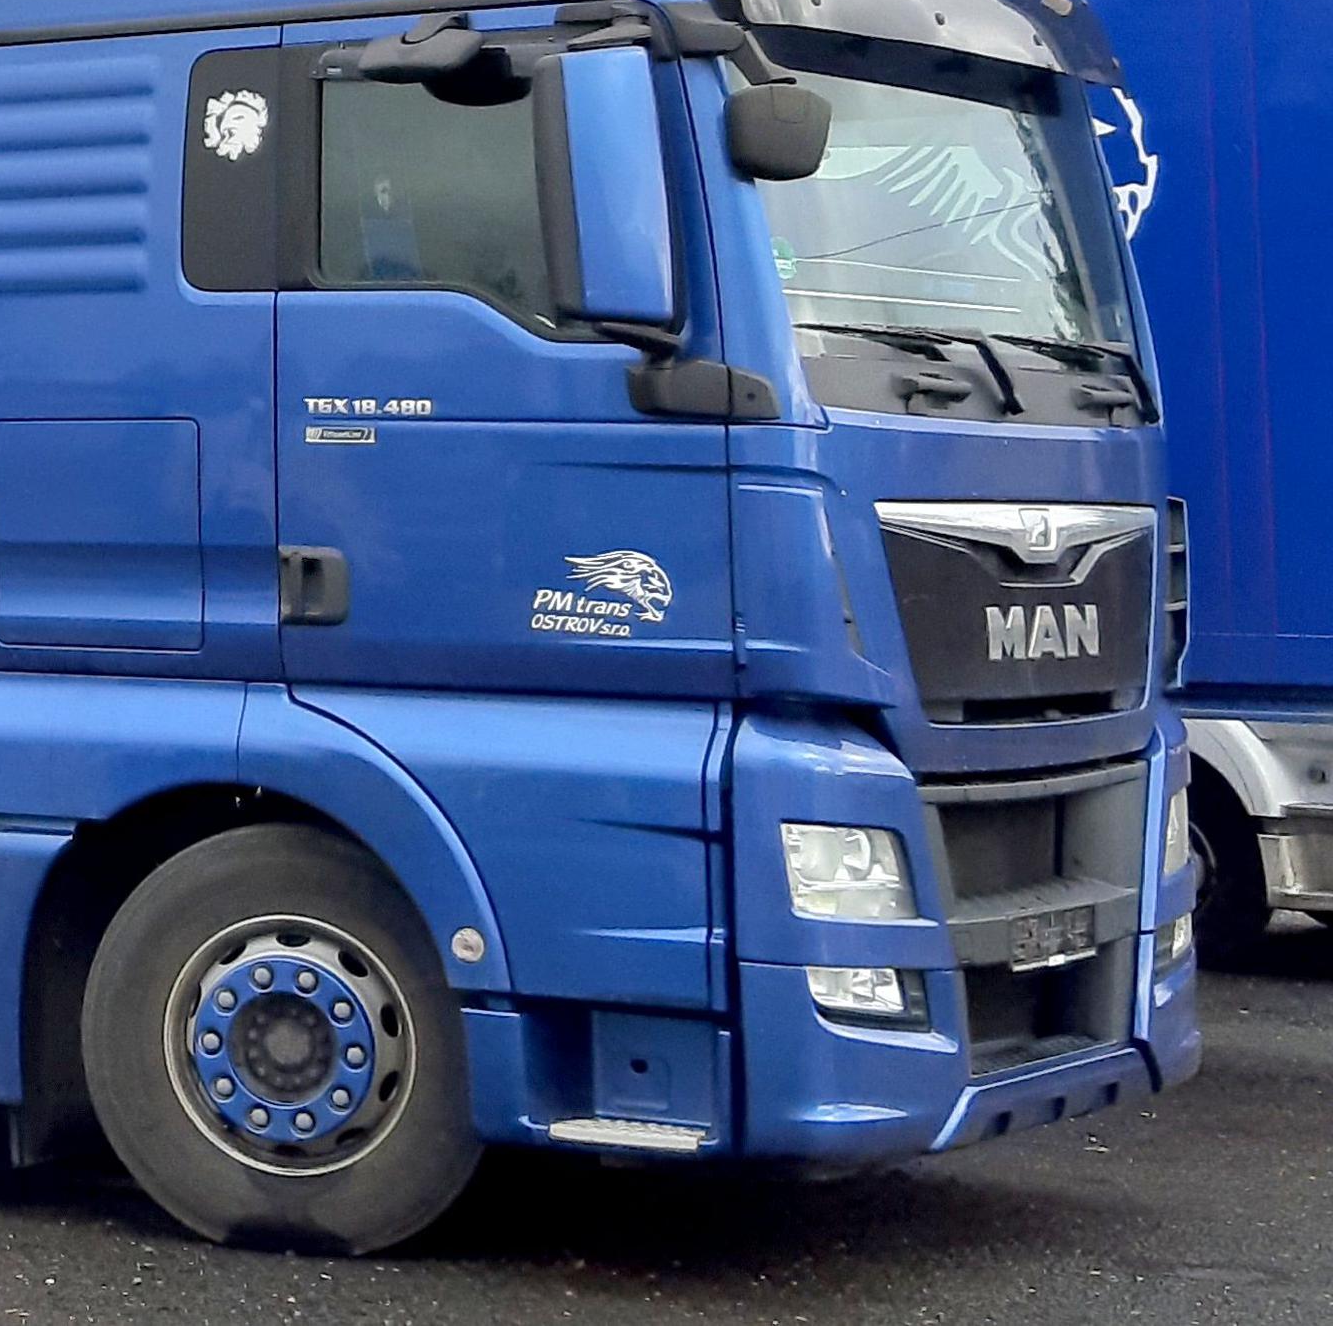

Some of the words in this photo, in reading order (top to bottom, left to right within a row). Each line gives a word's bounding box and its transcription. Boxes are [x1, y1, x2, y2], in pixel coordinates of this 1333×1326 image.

[303, 397, 349, 414] TGX
[352, 399, 432, 415] 18.480
[533, 589, 573, 611] PM
[576, 596, 633, 617] trans
[531, 613, 603, 633] OSTROV
[984, 604, 1100, 661] MAN
